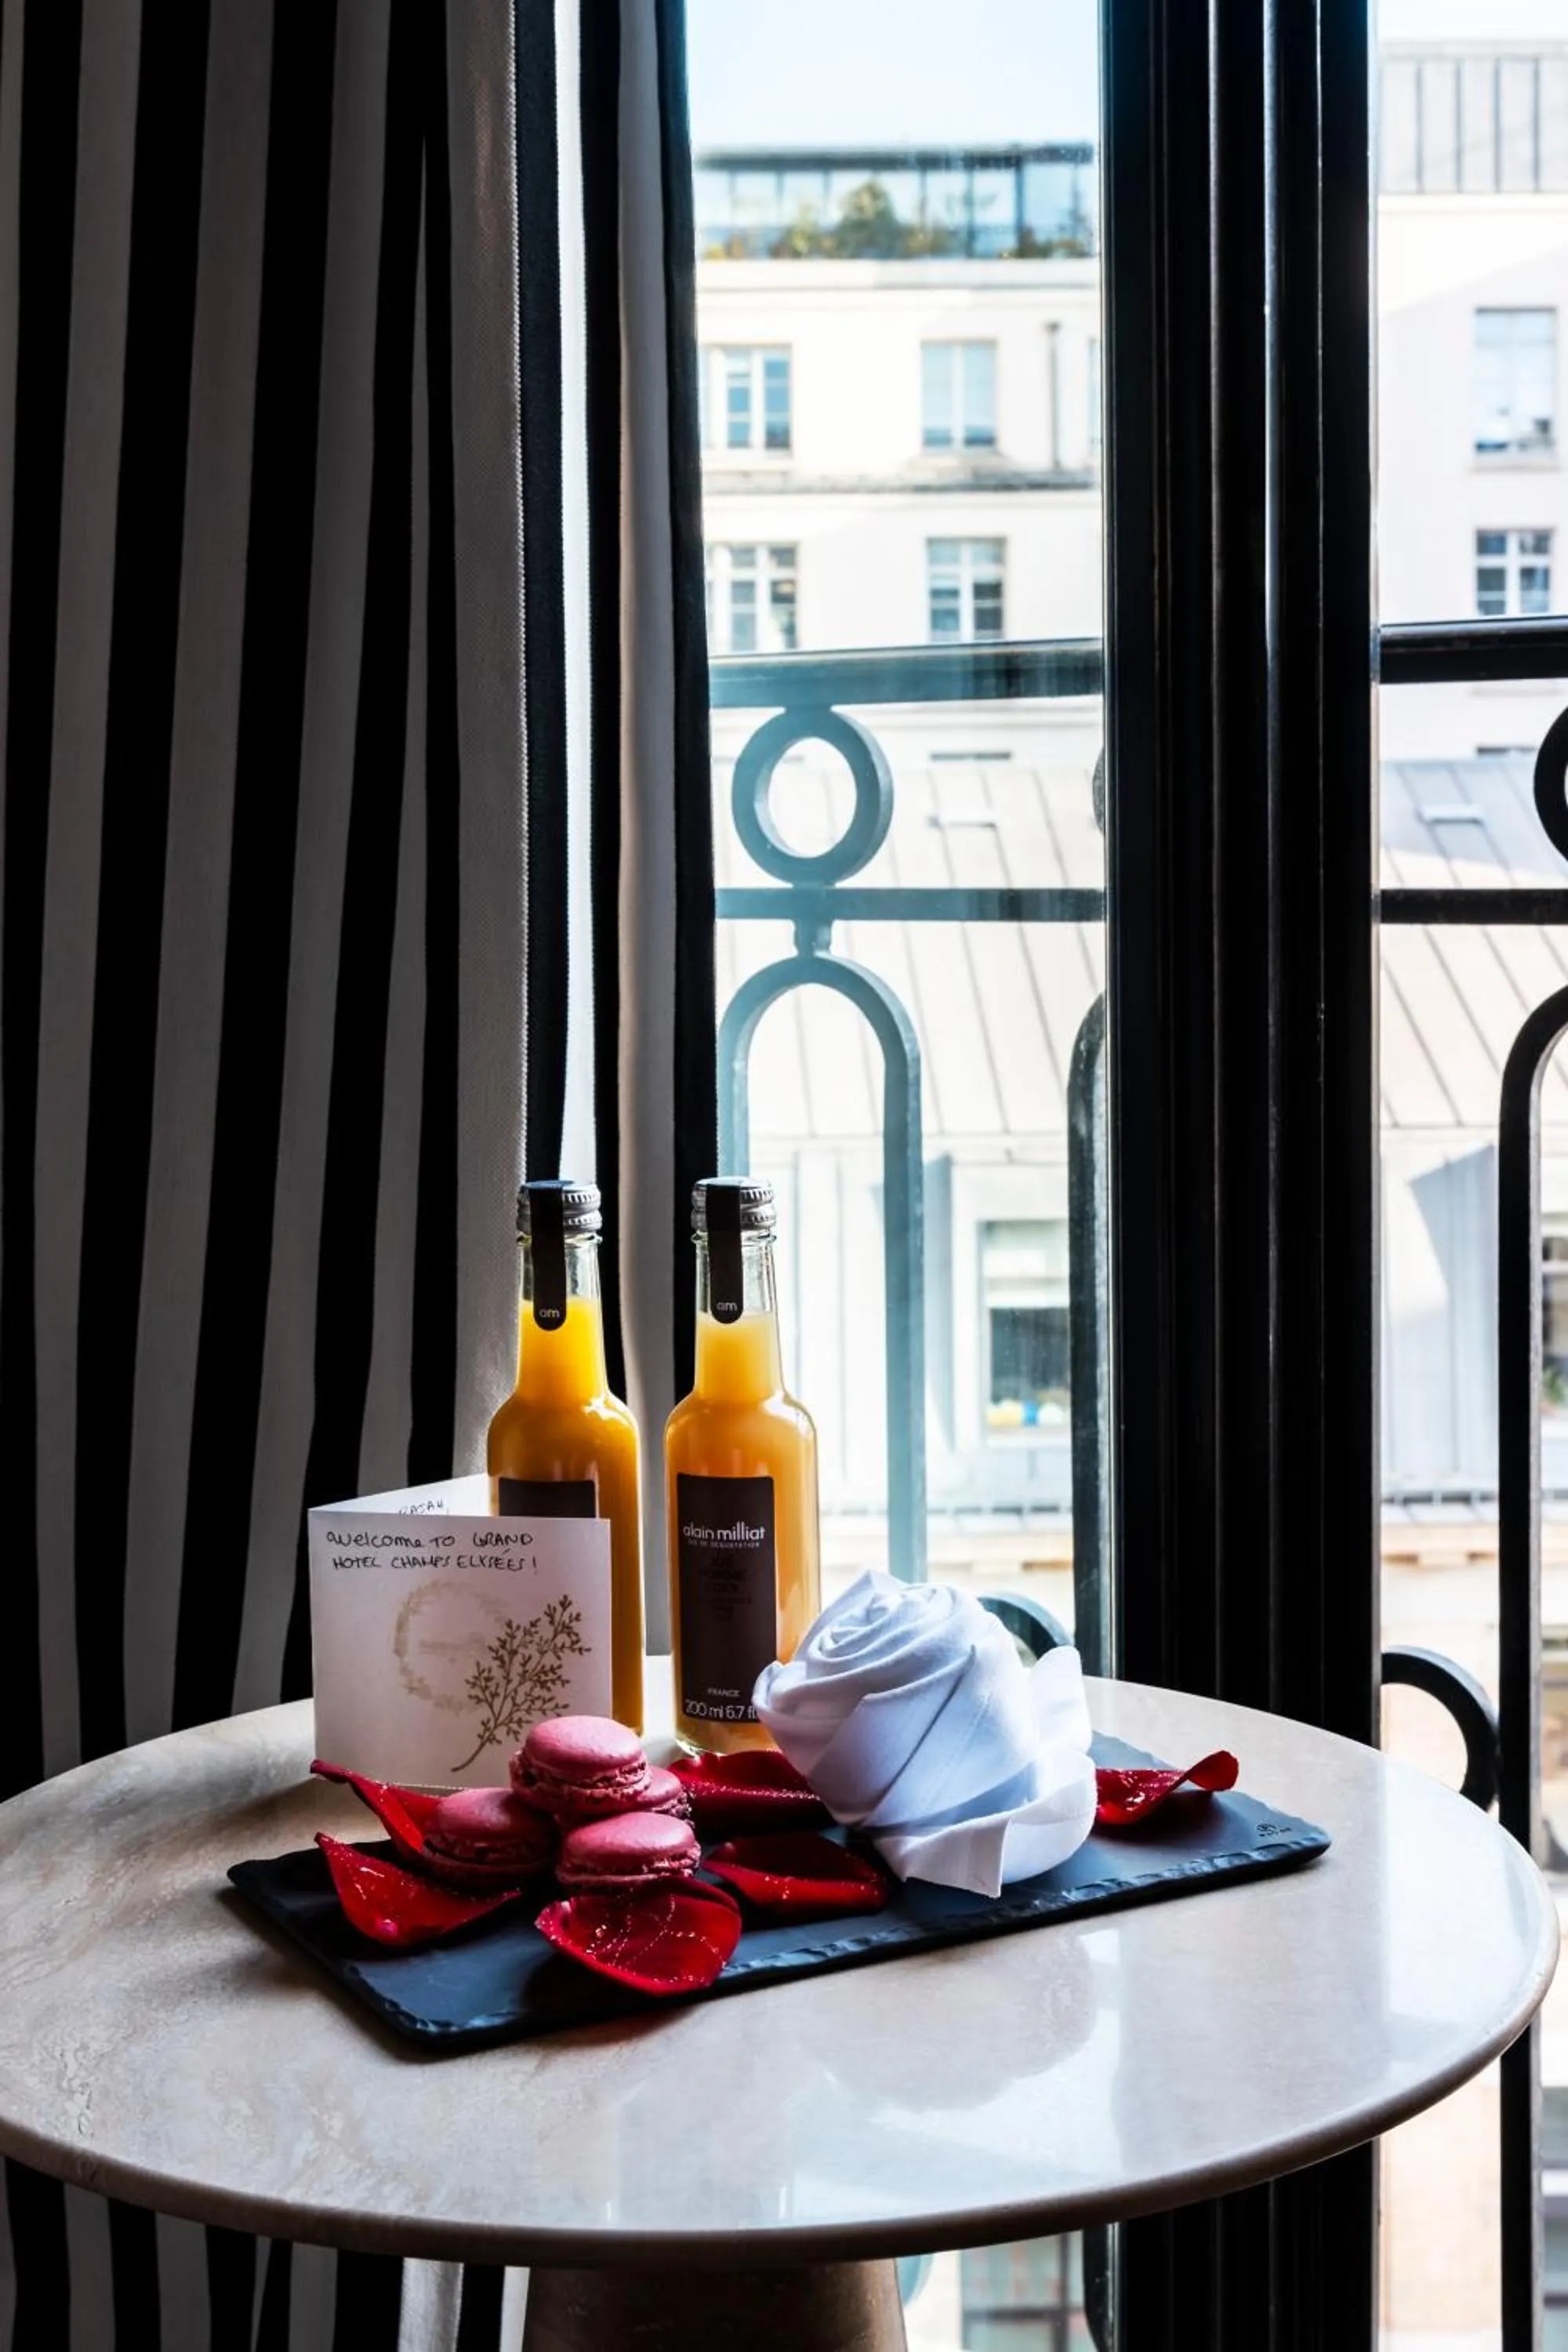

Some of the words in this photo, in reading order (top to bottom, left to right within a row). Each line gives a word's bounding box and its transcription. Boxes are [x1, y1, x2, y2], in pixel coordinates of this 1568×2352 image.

[717, 1301, 738, 1311] am
[683, 1521, 714, 1539] alain
[717, 1521, 766, 1541] milliat
[473, 1532, 535, 1548] GRAND
[332, 1555, 381, 1570] HOTEL
[391, 1555, 451, 1569] CHAMPS
[706, 1687, 741, 1697] FRANCE
[684, 1698, 707, 1716] 200
[709, 1705, 724, 1719] ml
[725, 1704, 746, 1719] 6.7
